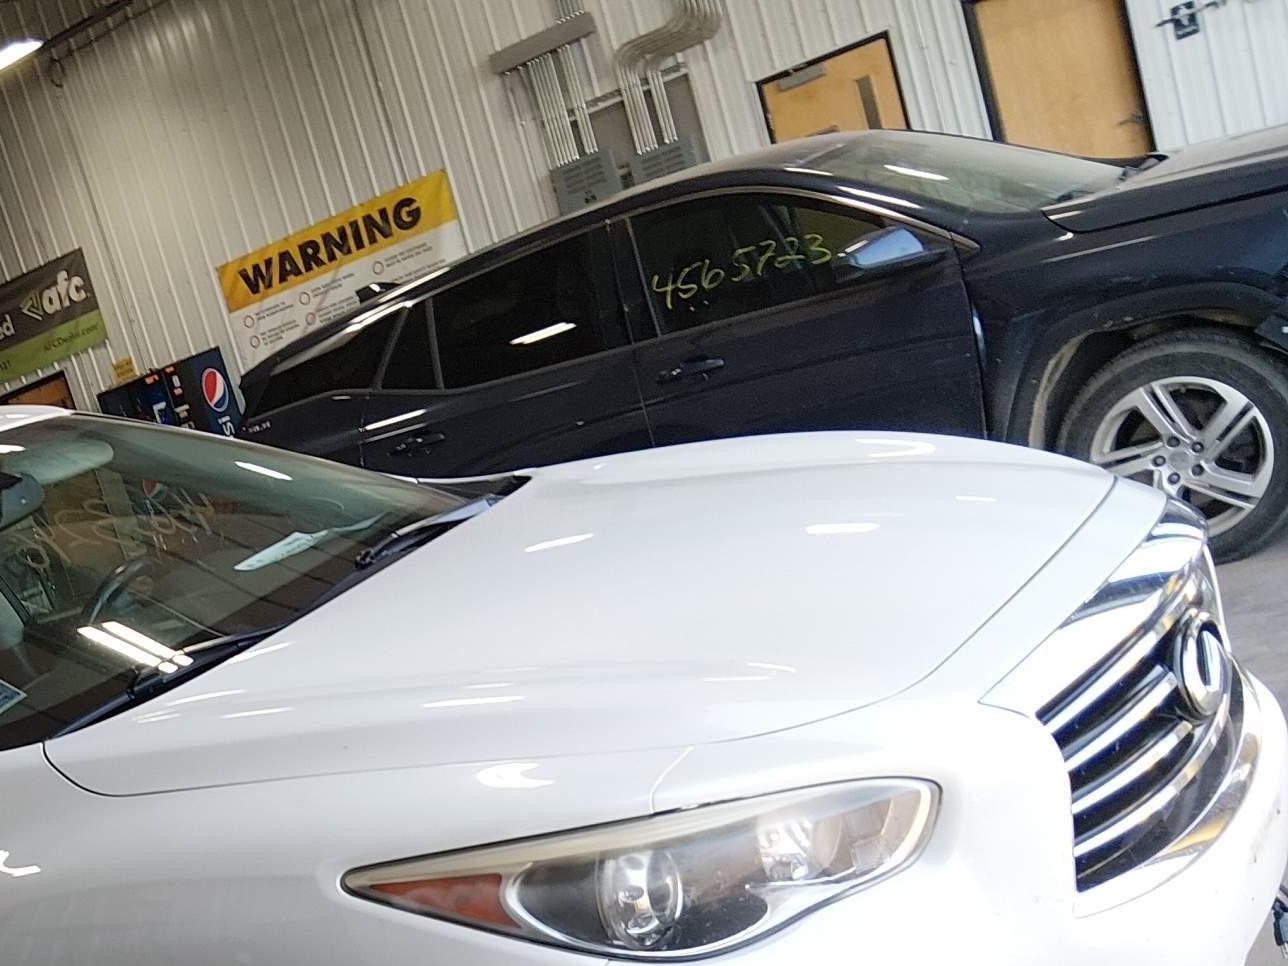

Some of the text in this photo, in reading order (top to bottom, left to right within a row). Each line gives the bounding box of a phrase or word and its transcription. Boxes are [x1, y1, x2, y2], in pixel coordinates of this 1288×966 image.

[238, 197, 422, 295] WARNING
[650, 233, 833, 311] 4565723
[41, 269, 87, 315] afc
